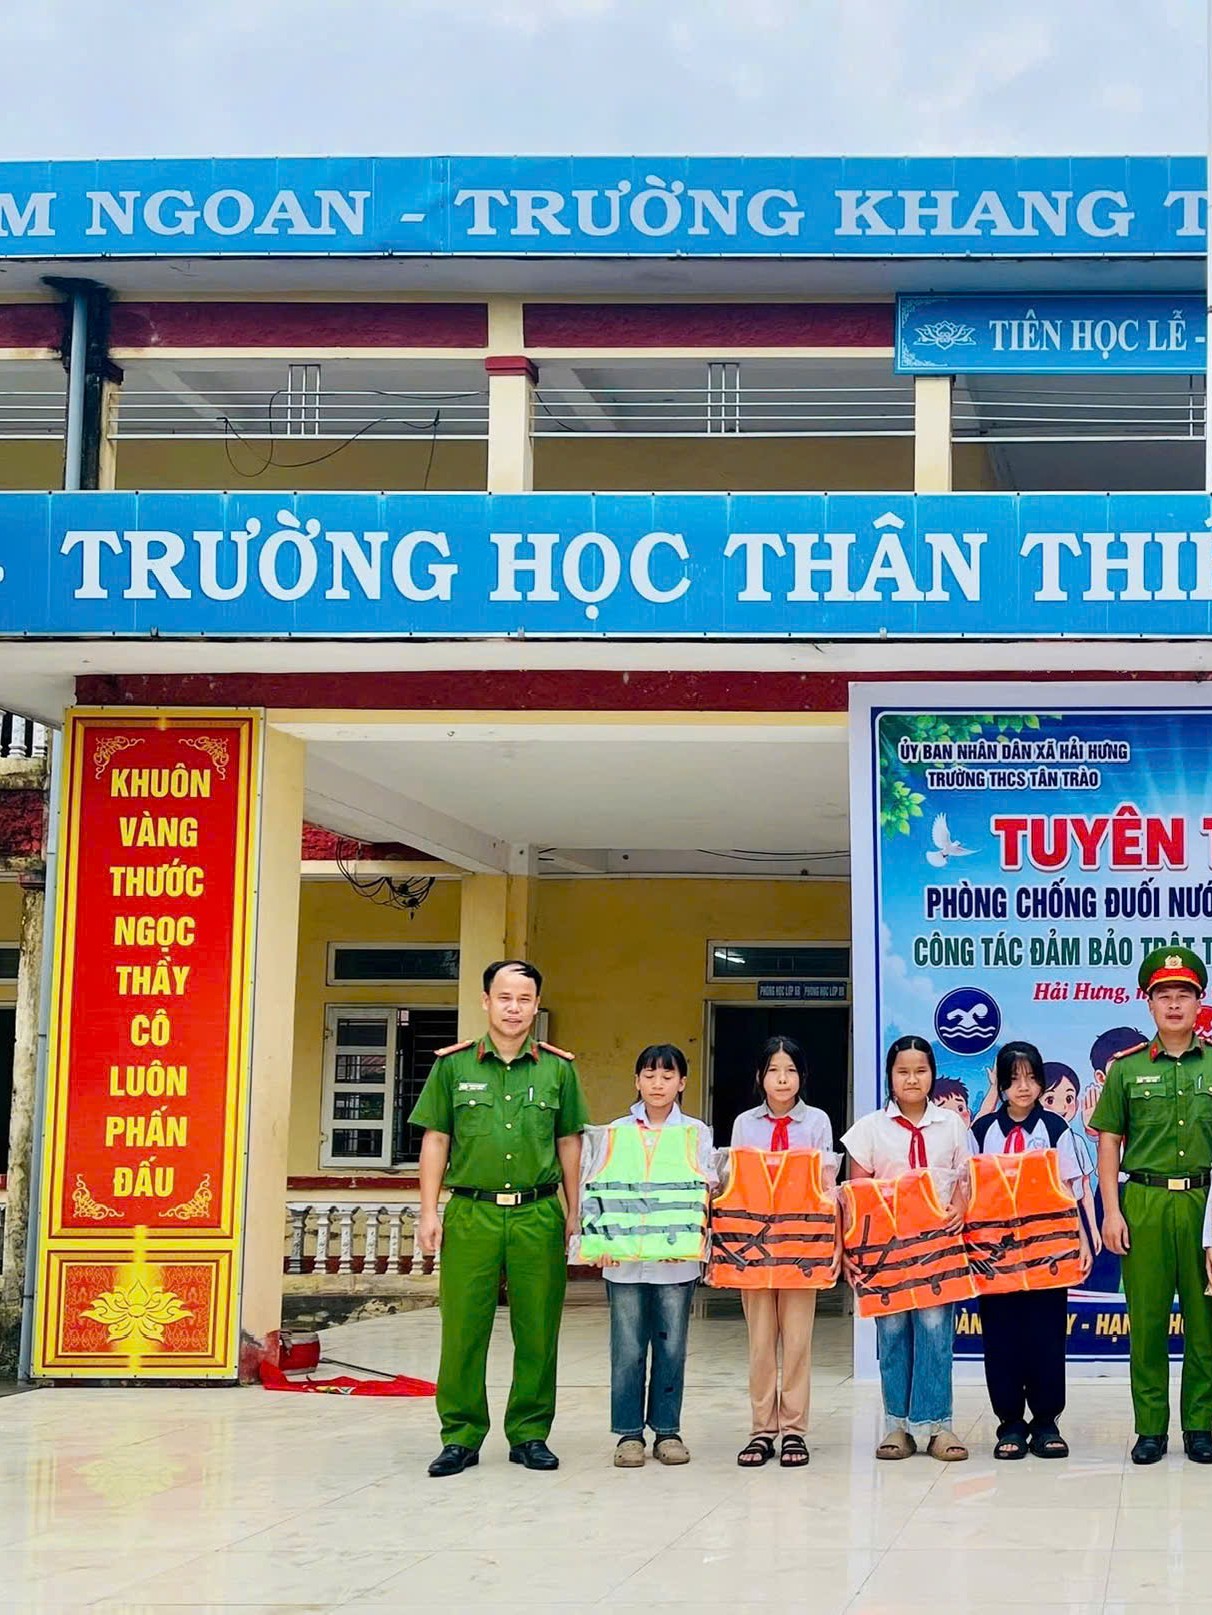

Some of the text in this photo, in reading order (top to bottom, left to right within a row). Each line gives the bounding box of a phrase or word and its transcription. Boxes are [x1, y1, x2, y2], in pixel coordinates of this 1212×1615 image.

[86, 190, 371, 236] NGOAN
[454, 175, 805, 236] TRƯỜNG
[835, 190, 1135, 237] KHANG
[989, 310, 1062, 352] TIÊN
[1070, 319, 1140, 360] HỌC
[1146, 309, 1188, 352] LỄ
[60, 509, 458, 602] TRƯỜNG
[489, 532, 692, 620] HỌC
[723, 511, 988, 602] THÂN
[899, 737, 1128, 760] ỦY BAN NHÂN DÂN XÃ HẢI HƯNG
[110, 763, 211, 798] KHUÔN
[927, 766, 1099, 788] TRƯỜNG THCS TÂN TRÀO
[119, 811, 198, 848] VÀNG
[994, 805, 1185, 867] TUYÊN
[109, 858, 204, 897] THƯỚC
[927, 880, 1007, 919] PHÒNG
[1016, 877, 1097, 919] CHỐNG
[1104, 877, 1161, 918] ĐUỐI
[114, 916, 195, 950] NGỌC
[914, 932, 974, 967] CÔNG
[980, 932, 1023, 967] TÁC
[1029, 928, 1080, 966] ĐẢM
[1088, 928, 1133, 966] BẢO
[115, 955, 190, 995] THẦY
[1033, 981, 1068, 1001] Hải
[1073, 983, 1130, 1004] Hưng,
[130, 1008, 170, 1047] CÔ
[109, 1059, 188, 1097] LUÔN
[105, 1105, 188, 1147] PHẤN
[112, 1157, 175, 1197] ĐẤU
